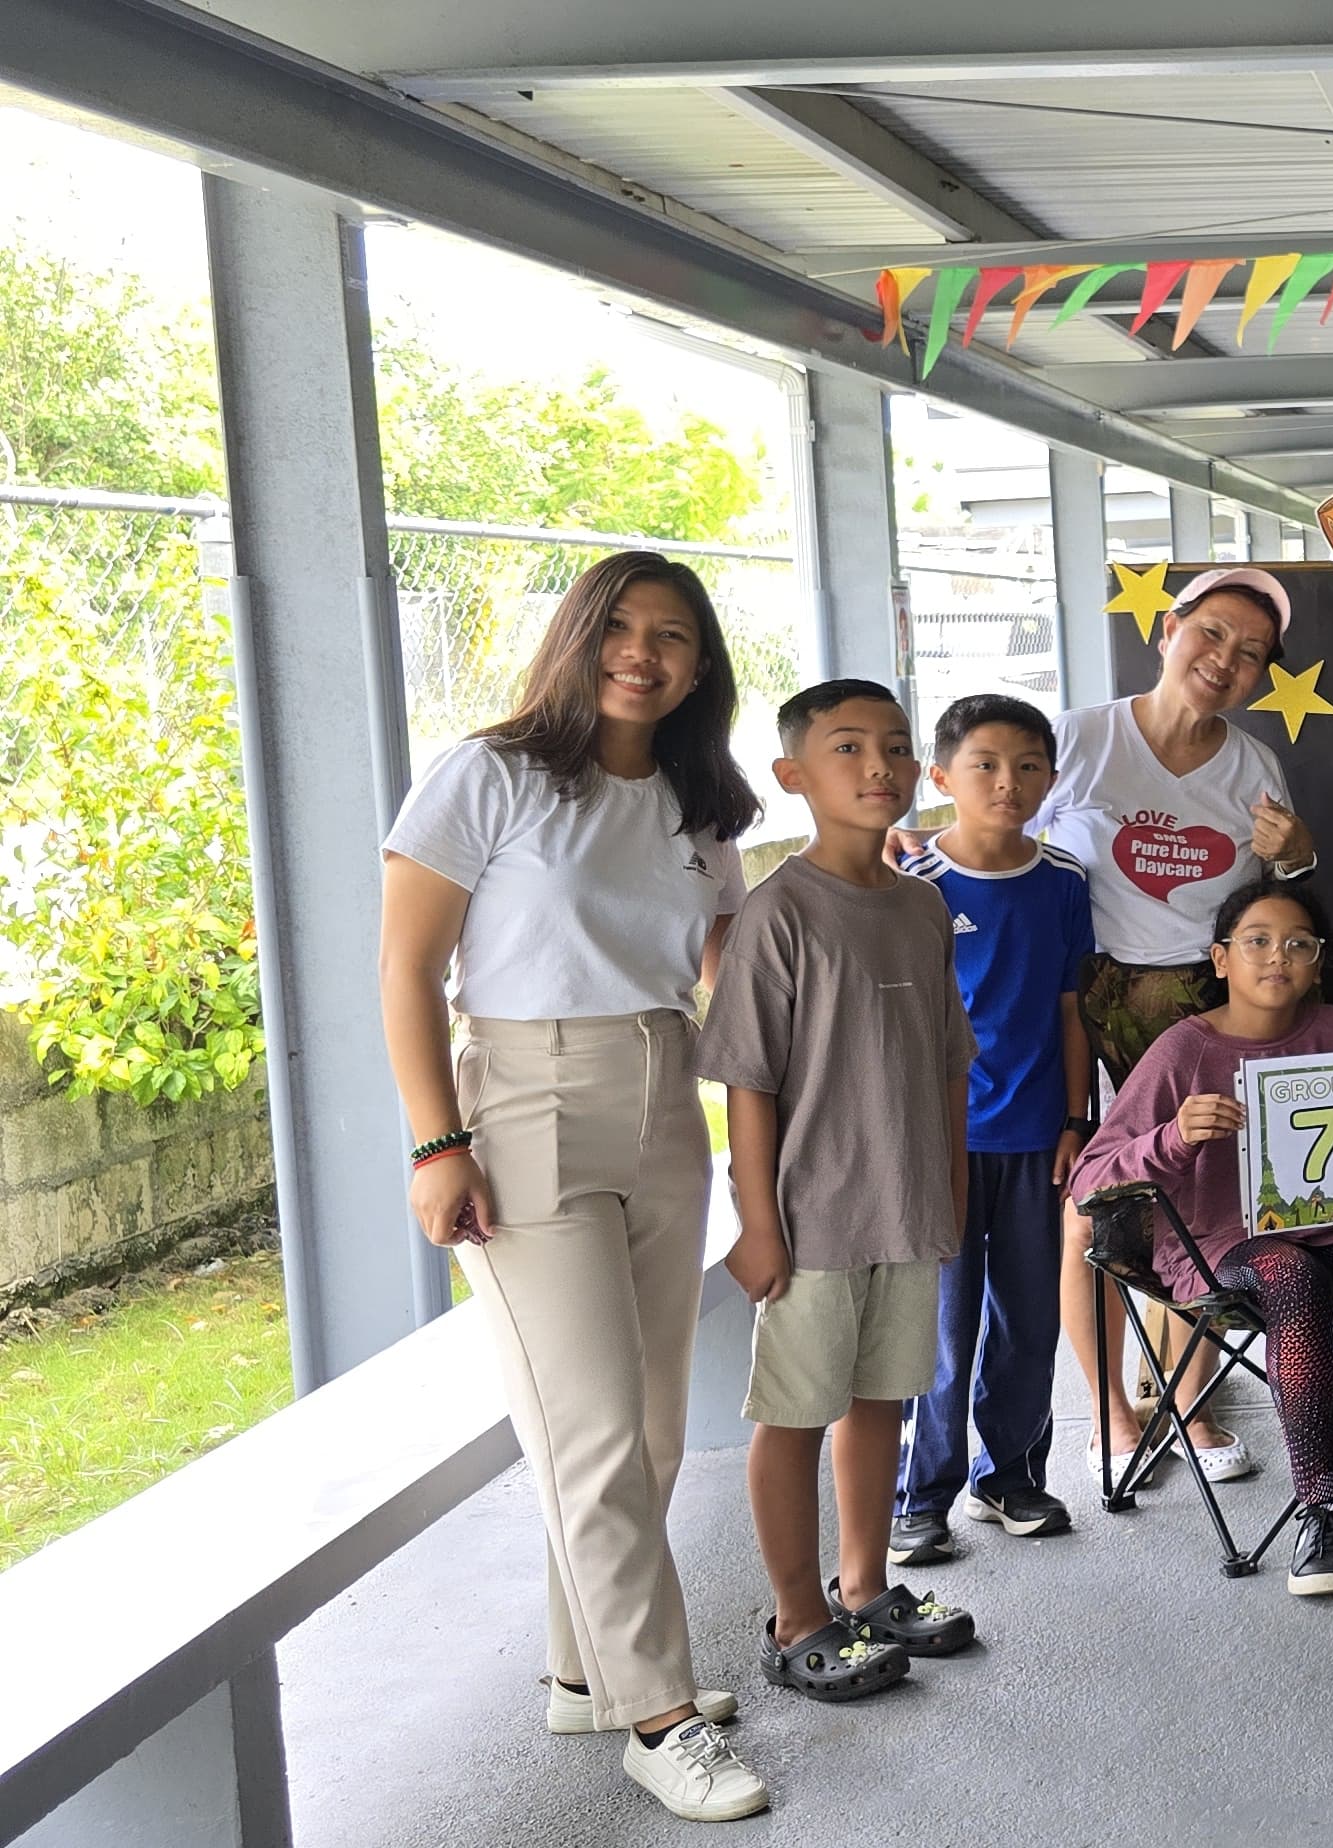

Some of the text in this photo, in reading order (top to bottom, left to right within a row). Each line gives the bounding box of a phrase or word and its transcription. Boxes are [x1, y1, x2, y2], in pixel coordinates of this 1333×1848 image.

[1122, 809, 1179, 829] LOVE
[1131, 839, 1209, 861] Pure Love
[1135, 857, 1203, 878] Daycare
